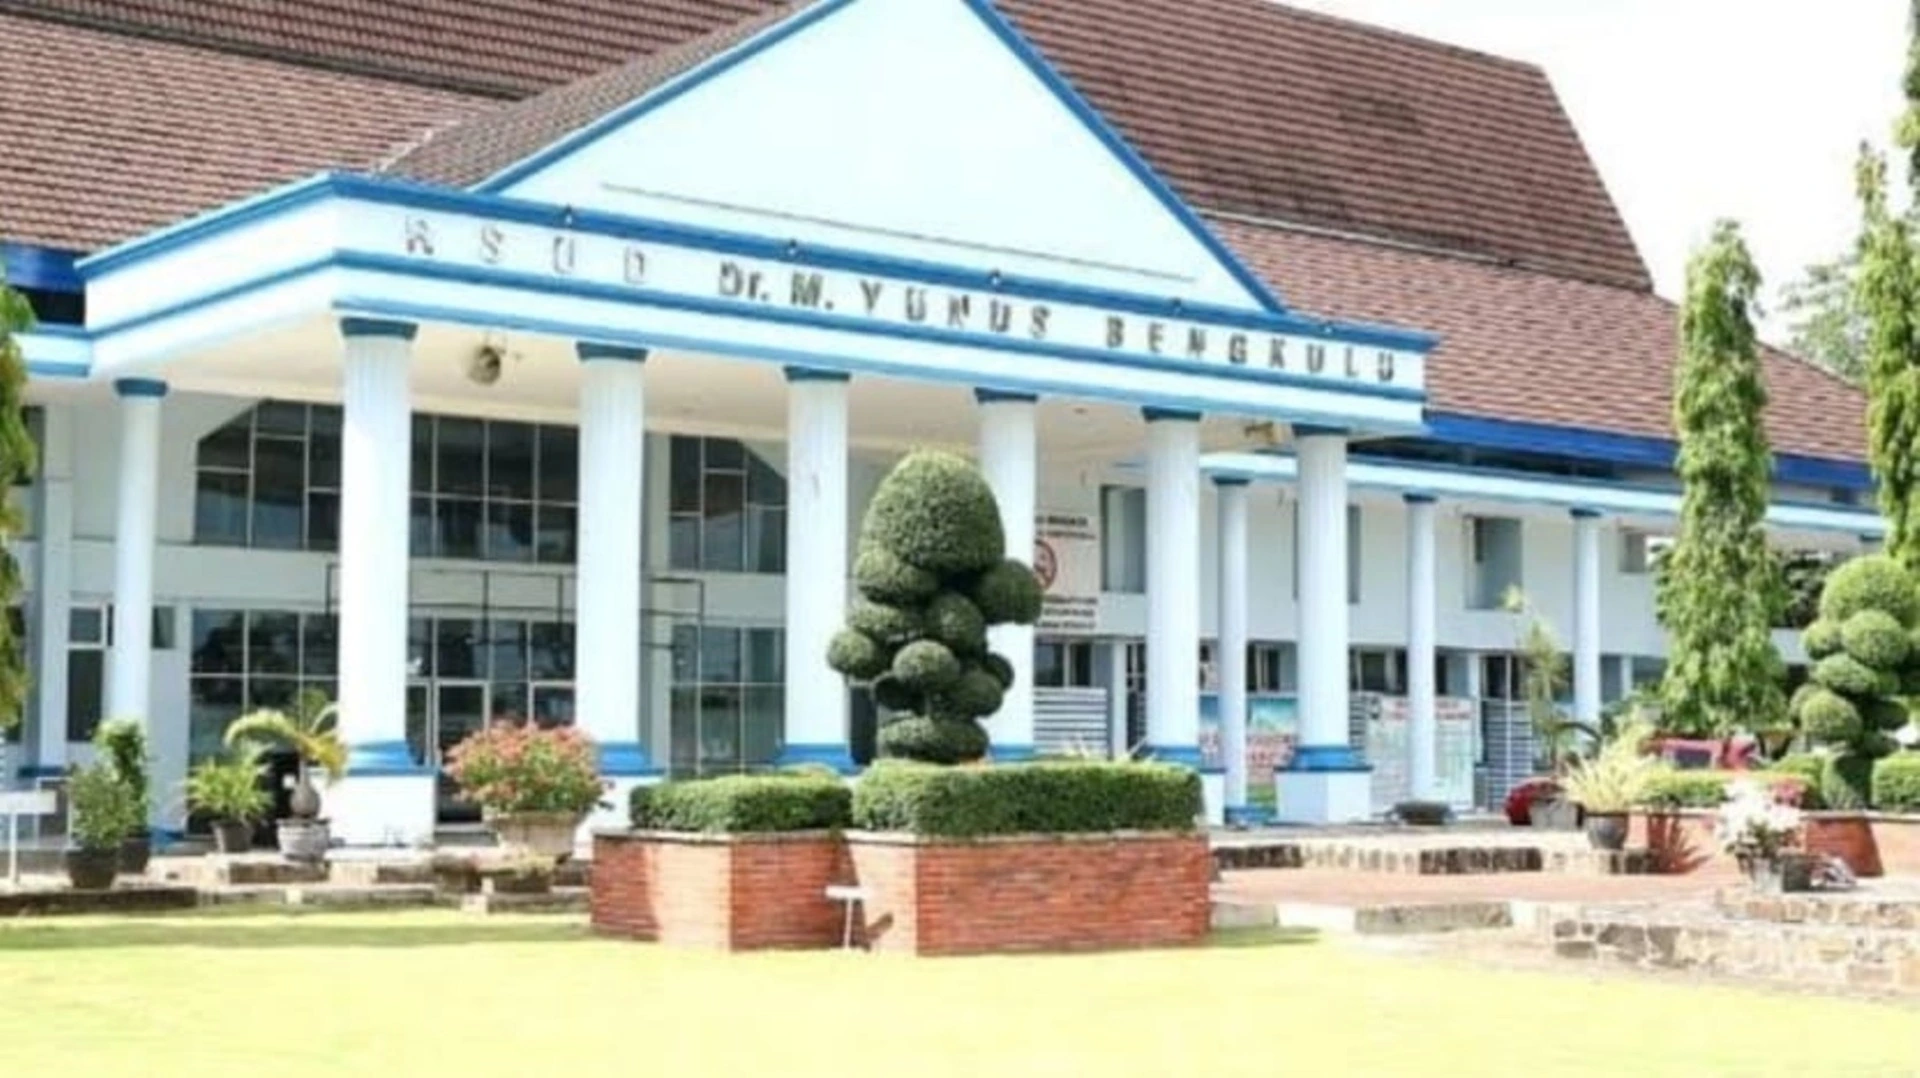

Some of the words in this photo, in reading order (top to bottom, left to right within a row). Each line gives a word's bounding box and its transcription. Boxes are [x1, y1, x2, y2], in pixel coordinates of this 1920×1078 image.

[718, 261, 768, 301] Dr.
[790, 272, 834, 311] M.
[859, 279, 1051, 339] YUNUS
[1106, 316, 1394, 382] BENGKULU
